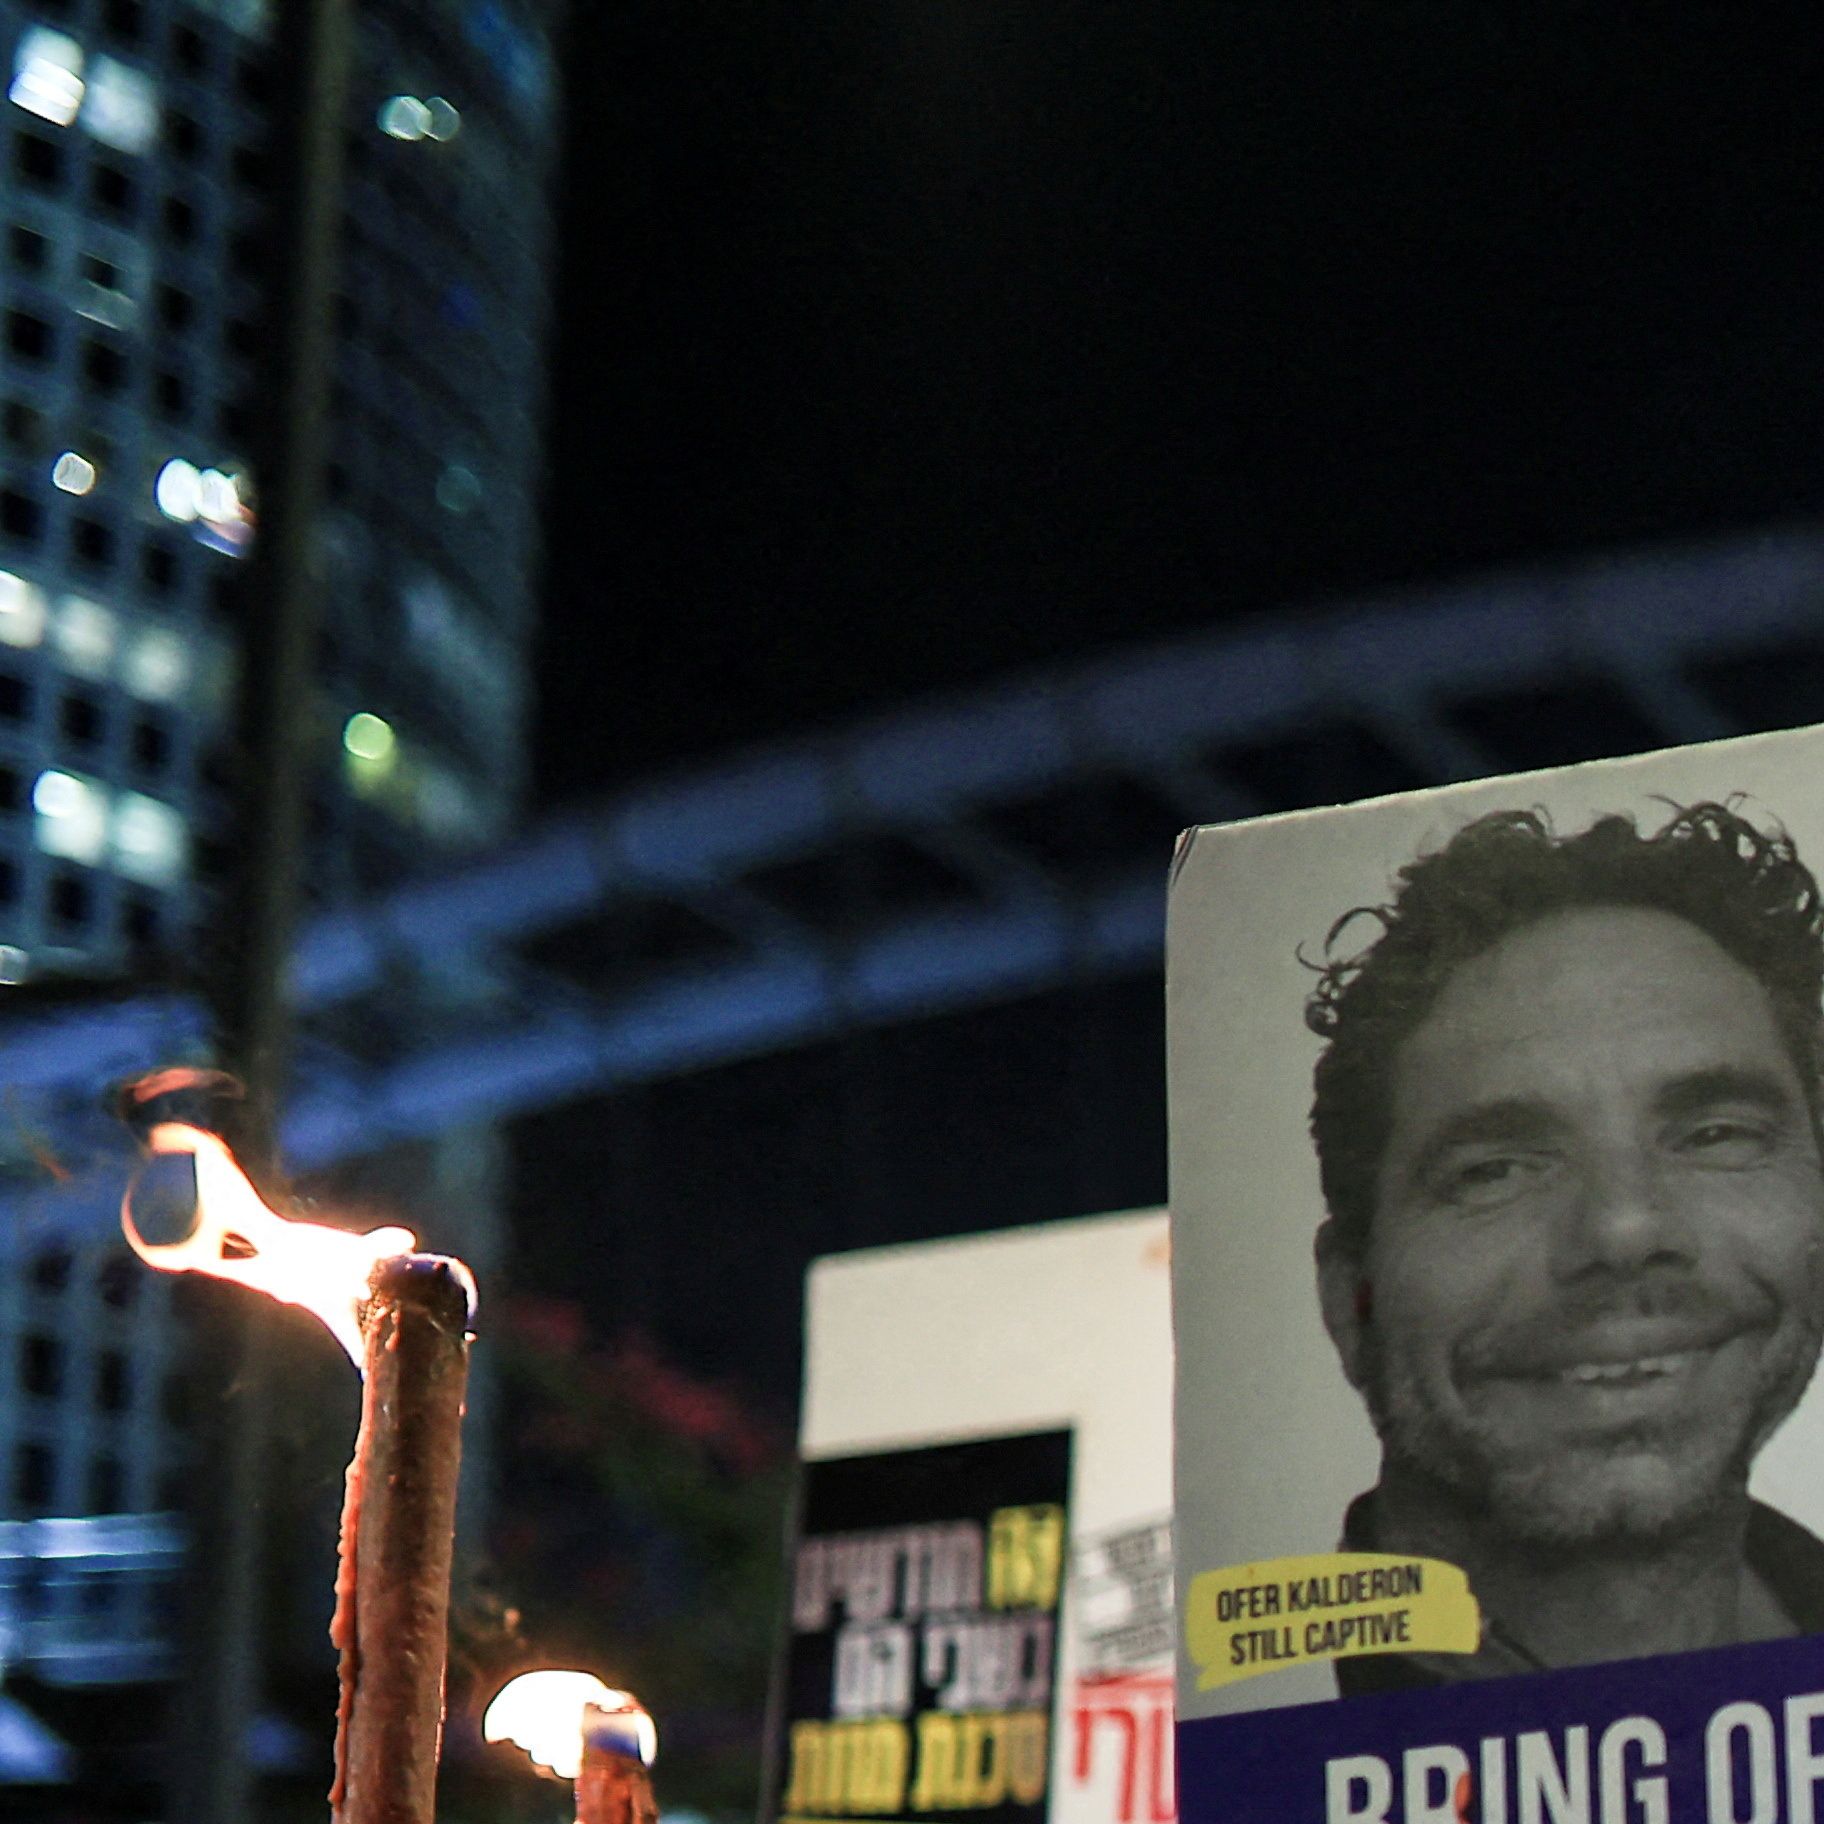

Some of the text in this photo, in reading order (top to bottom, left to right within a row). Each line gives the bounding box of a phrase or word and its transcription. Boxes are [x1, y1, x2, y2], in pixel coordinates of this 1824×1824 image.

[1216, 1564, 1422, 1622] OFER KALDERON
[1230, 1610, 1411, 1666] STILL CAPTIVE
